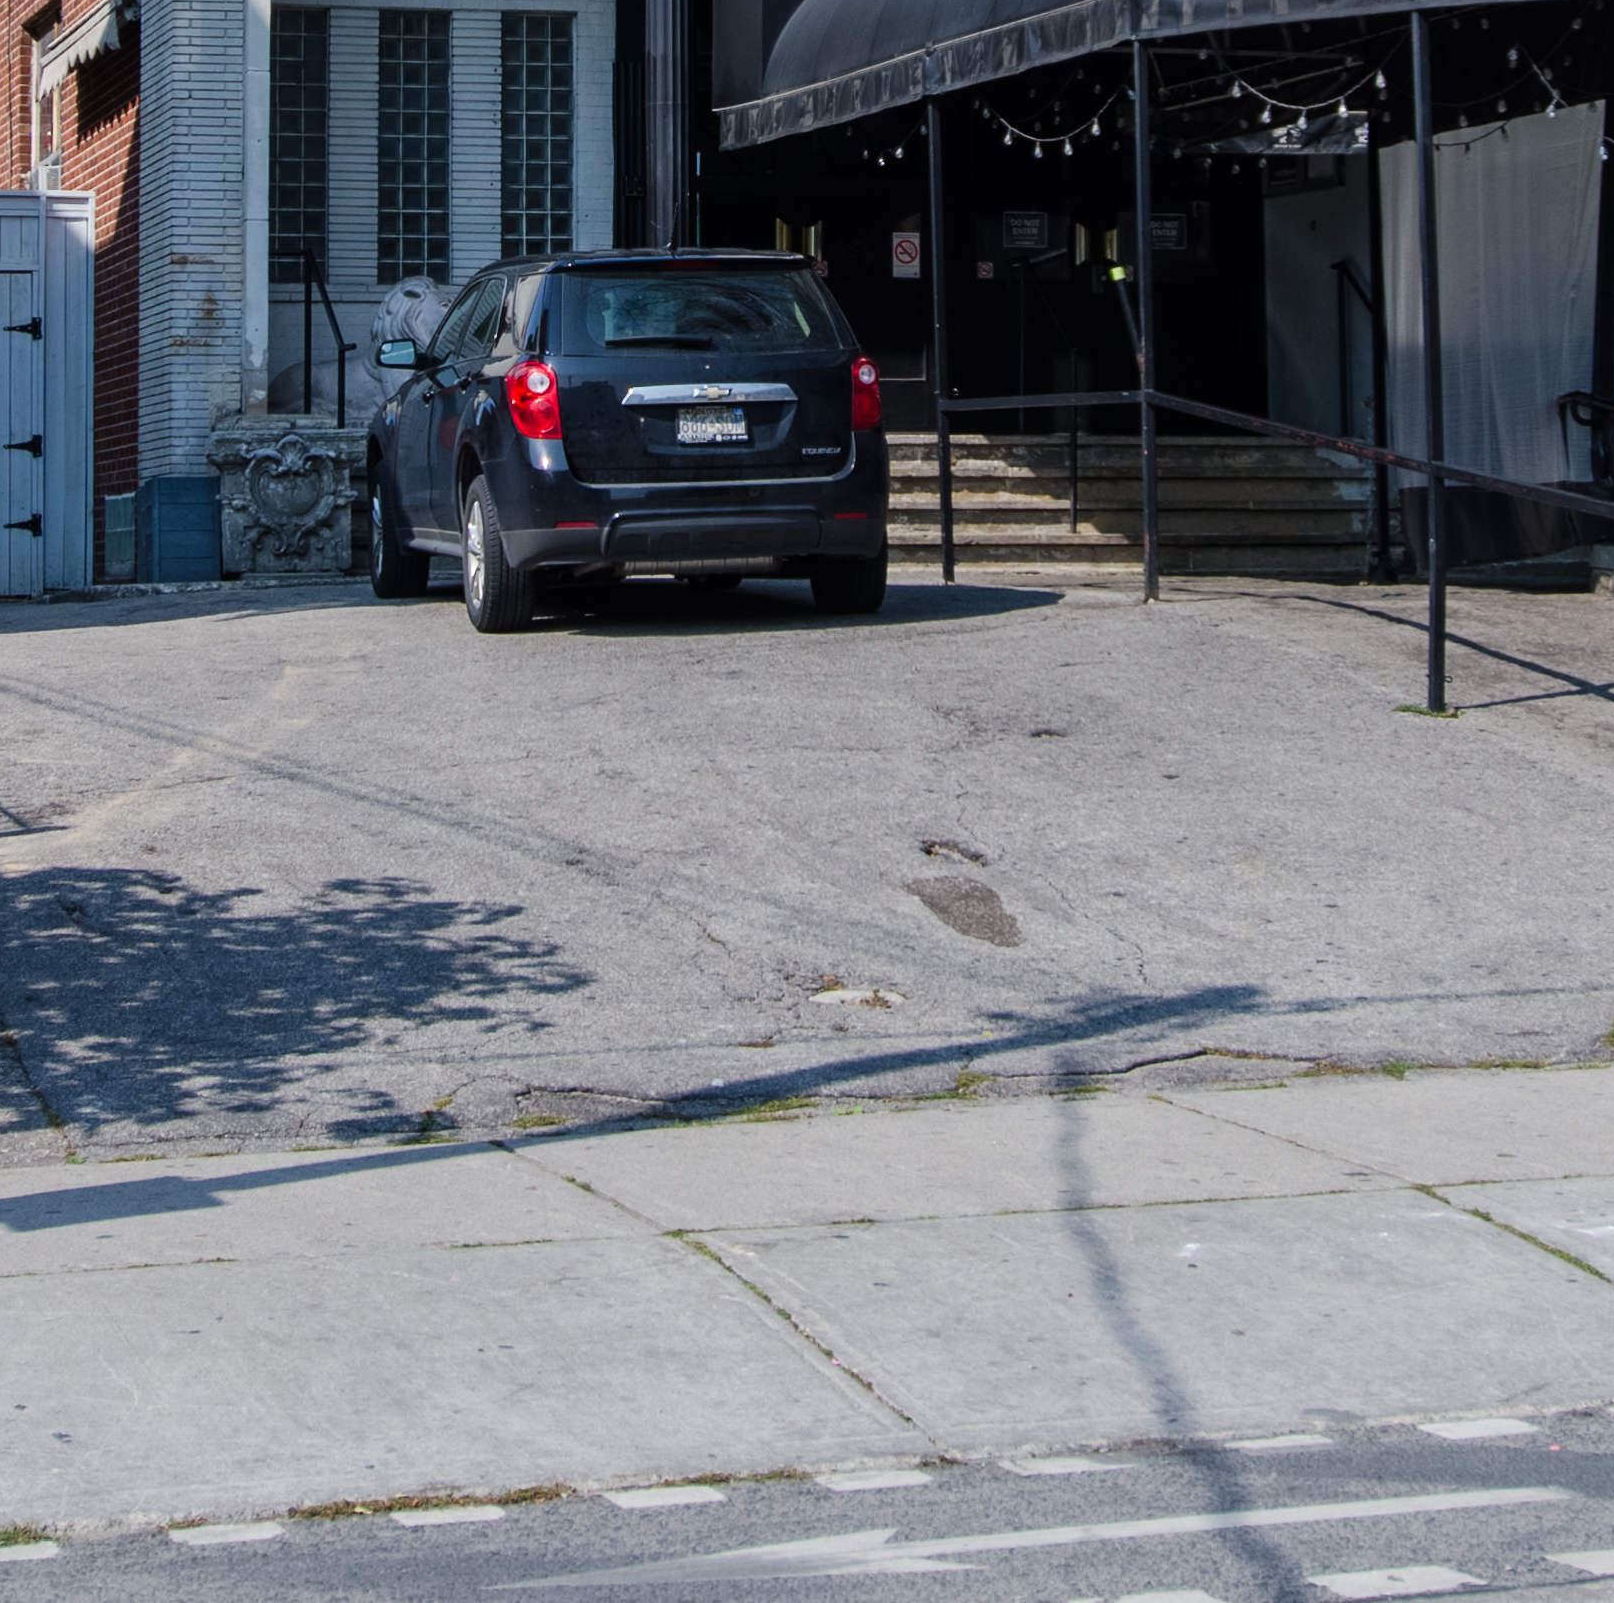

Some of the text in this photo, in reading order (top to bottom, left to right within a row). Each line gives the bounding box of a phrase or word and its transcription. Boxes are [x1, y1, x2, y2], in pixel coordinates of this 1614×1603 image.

[1010, 219, 1040, 227] DO NOT
[1163, 220, 1179, 228] NOT
[1012, 227, 1038, 235] ENTER
[1152, 228, 1178, 237] ENTER
